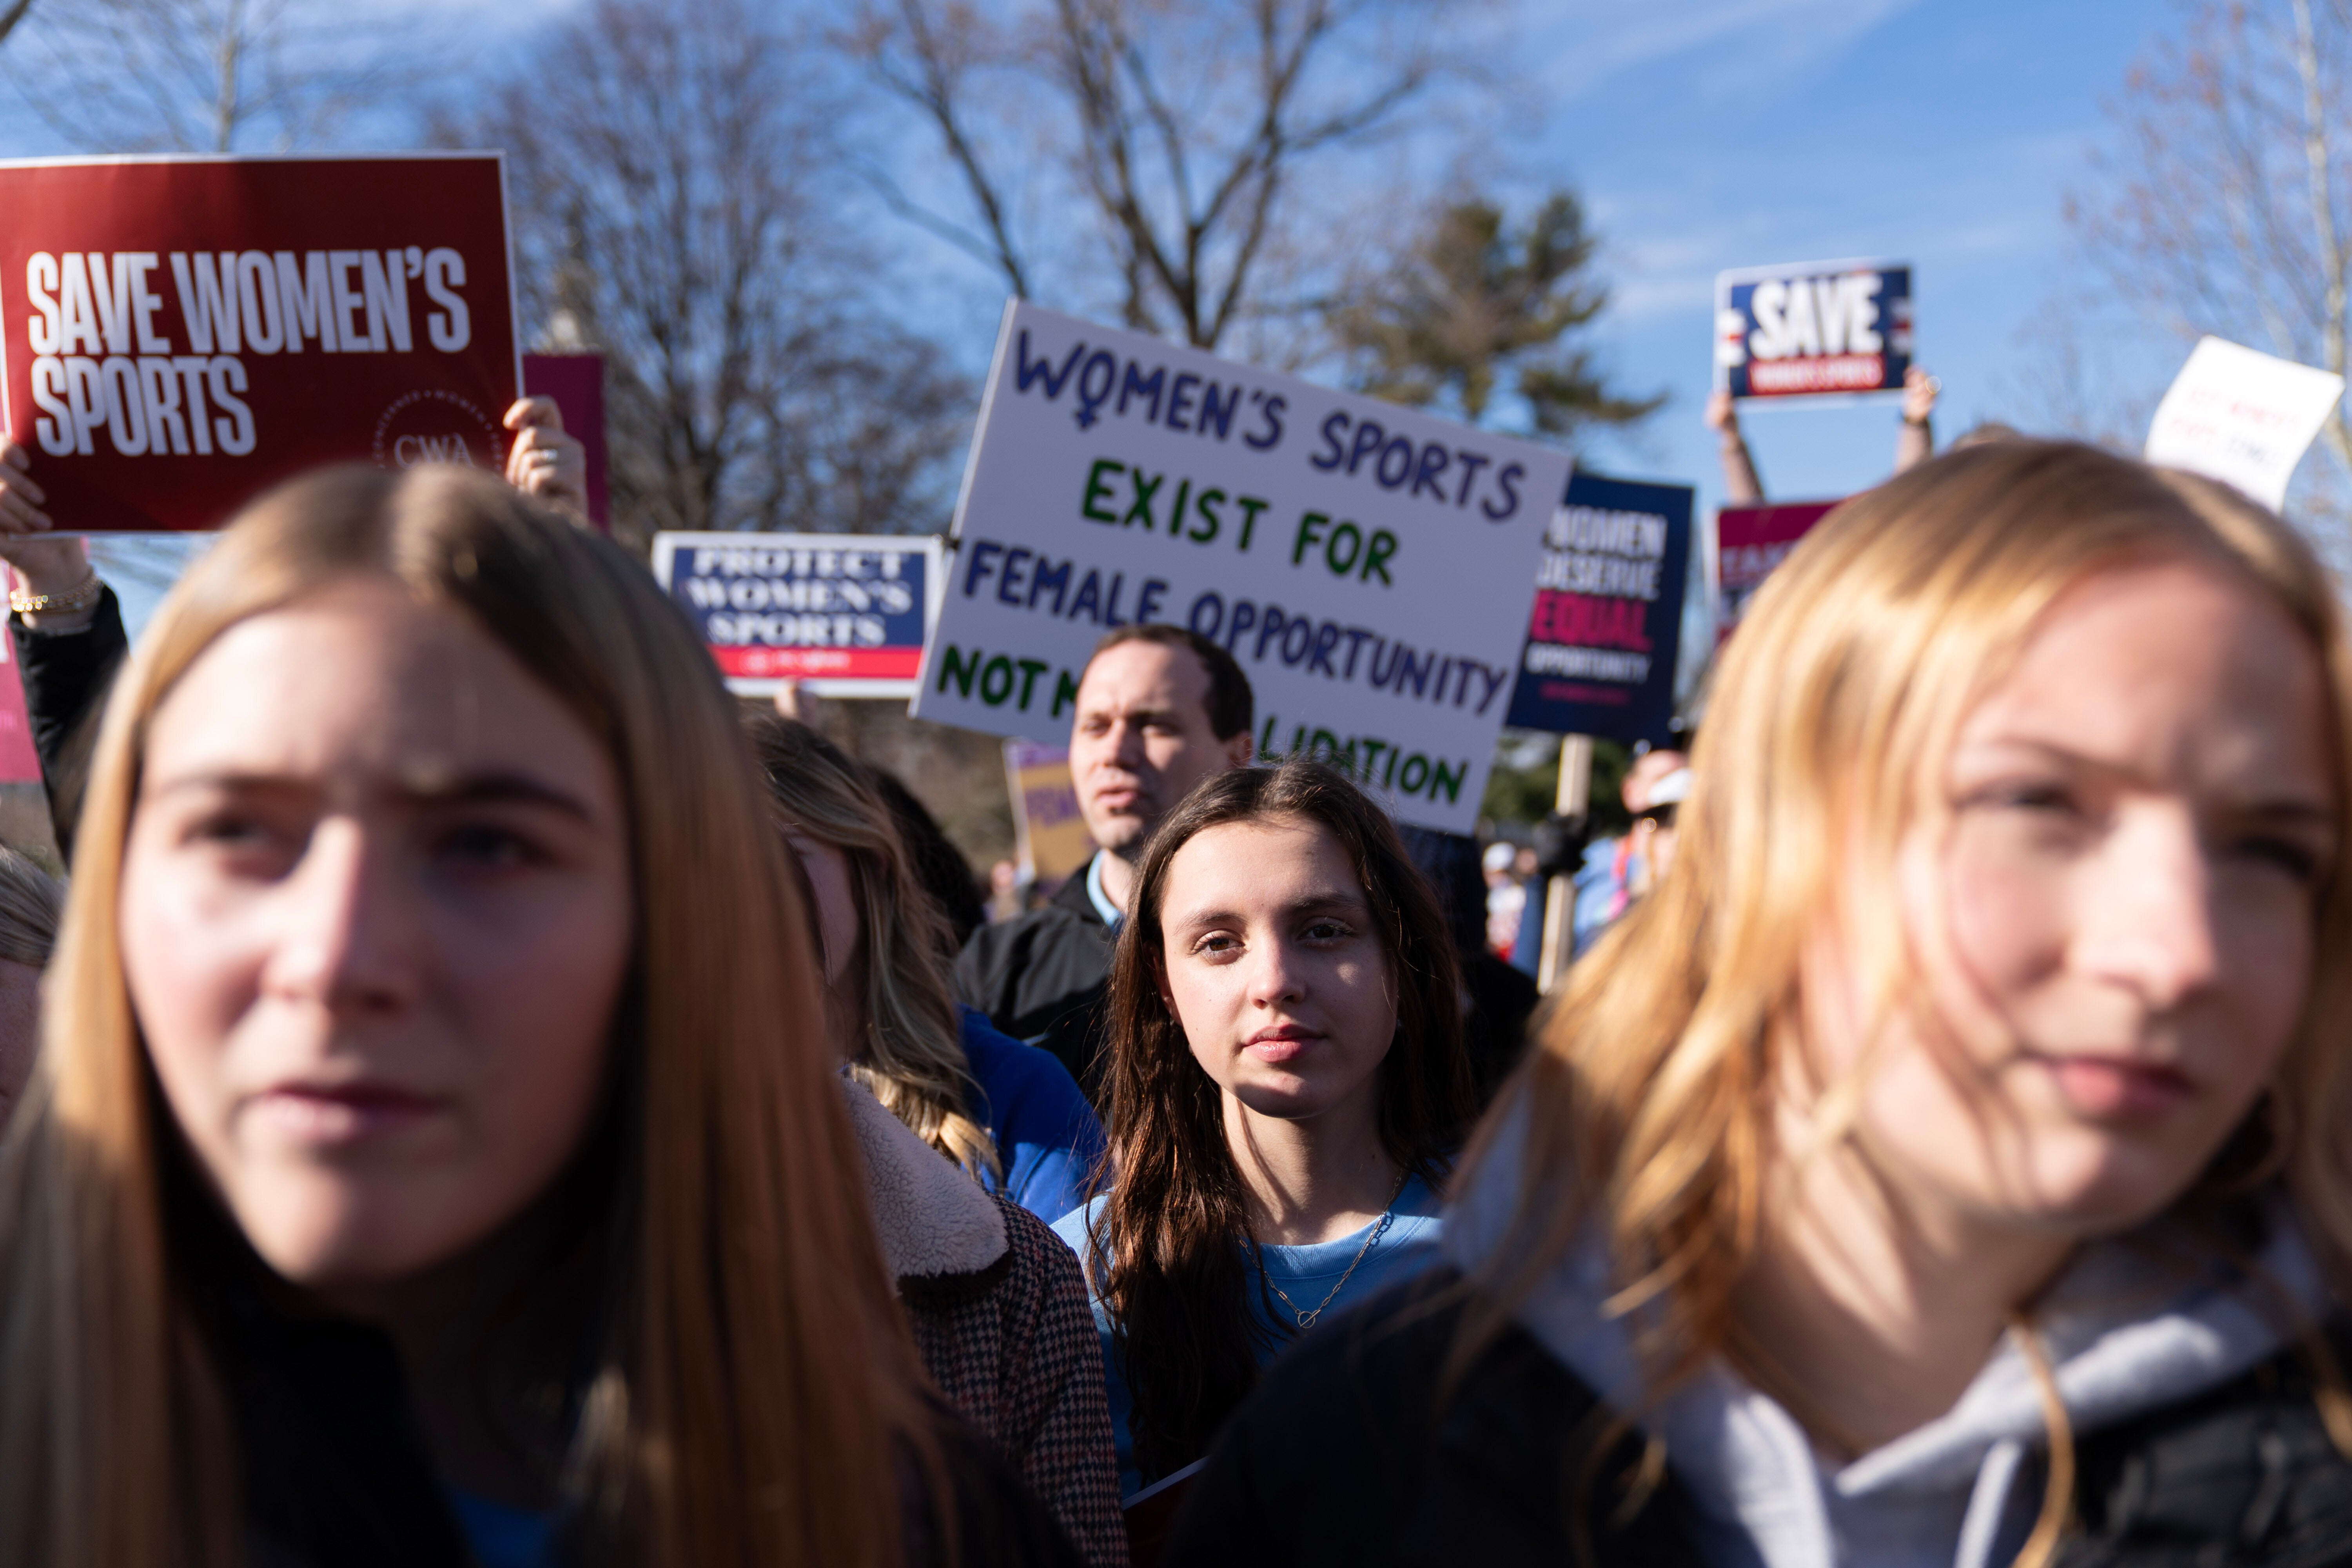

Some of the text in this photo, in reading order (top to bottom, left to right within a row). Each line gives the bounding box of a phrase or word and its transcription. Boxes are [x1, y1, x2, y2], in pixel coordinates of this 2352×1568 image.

[26, 246, 472, 355] SAVE WOMEN'S
[1749, 273, 1883, 361] SAVE
[31, 355, 257, 457] SPORTS
[394, 432, 475, 470] CWA
[1017, 330, 1525, 521] WOMEN'S SPORTS
[692, 548, 909, 579] PROTECT
[1082, 459, 1397, 585] EXIST FOR
[686, 577, 913, 615] WOMEN'S
[707, 610, 886, 648] SPORTS
[965, 541, 1169, 627] FEMALE
[1189, 590, 1508, 716] OPPORTUNITY
[1530, 588, 1653, 654] EQUAL
[937, 644, 1048, 712] NOT
[1257, 716, 1470, 804] LIDATION
